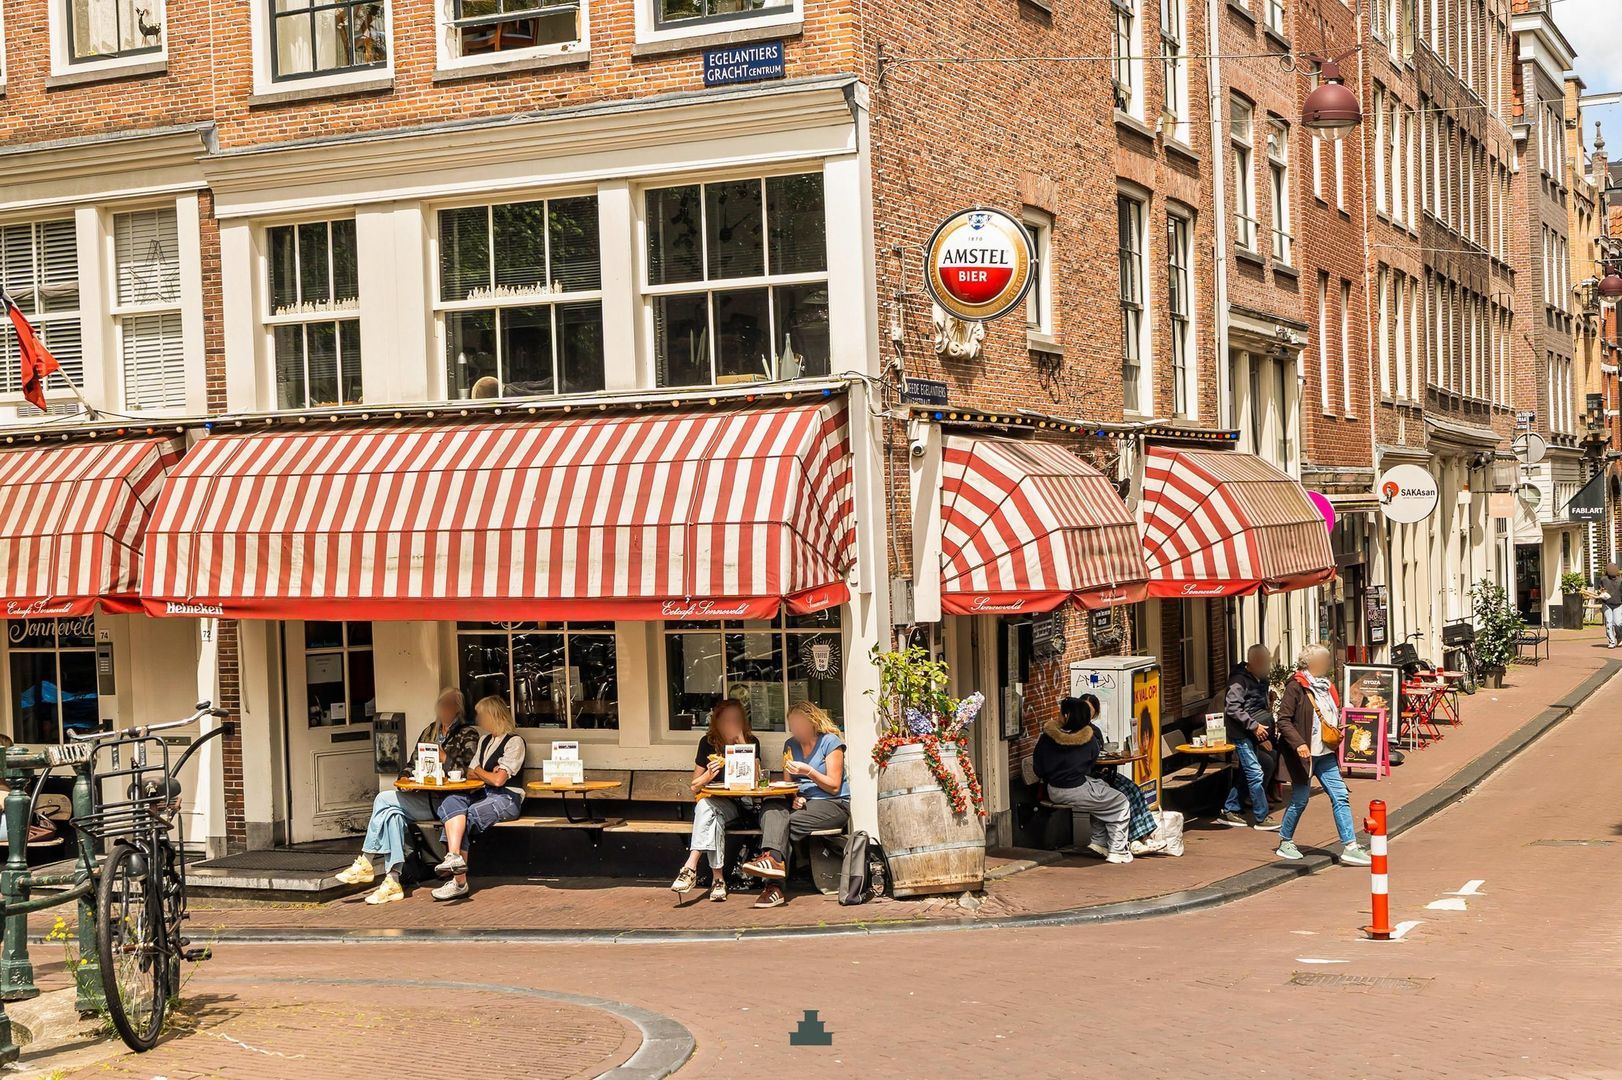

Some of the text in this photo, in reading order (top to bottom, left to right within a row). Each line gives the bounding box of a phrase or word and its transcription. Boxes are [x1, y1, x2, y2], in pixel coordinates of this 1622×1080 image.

[709, 46, 778, 66] EGELANTIERS
[707, 64, 781, 81] GRACHT CENTRUM
[943, 248, 1009, 265] AMSTEL
[958, 270, 988, 282] BIER
[1401, 488, 1436, 497] SAKAsan
[166, 602, 224, 615] Heineken
[695, 600, 750, 616] Sonneveld
[971, 596, 1026, 611] Sonneveld
[100, 631, 109, 640] 74
[203, 630, 211, 638] 72
